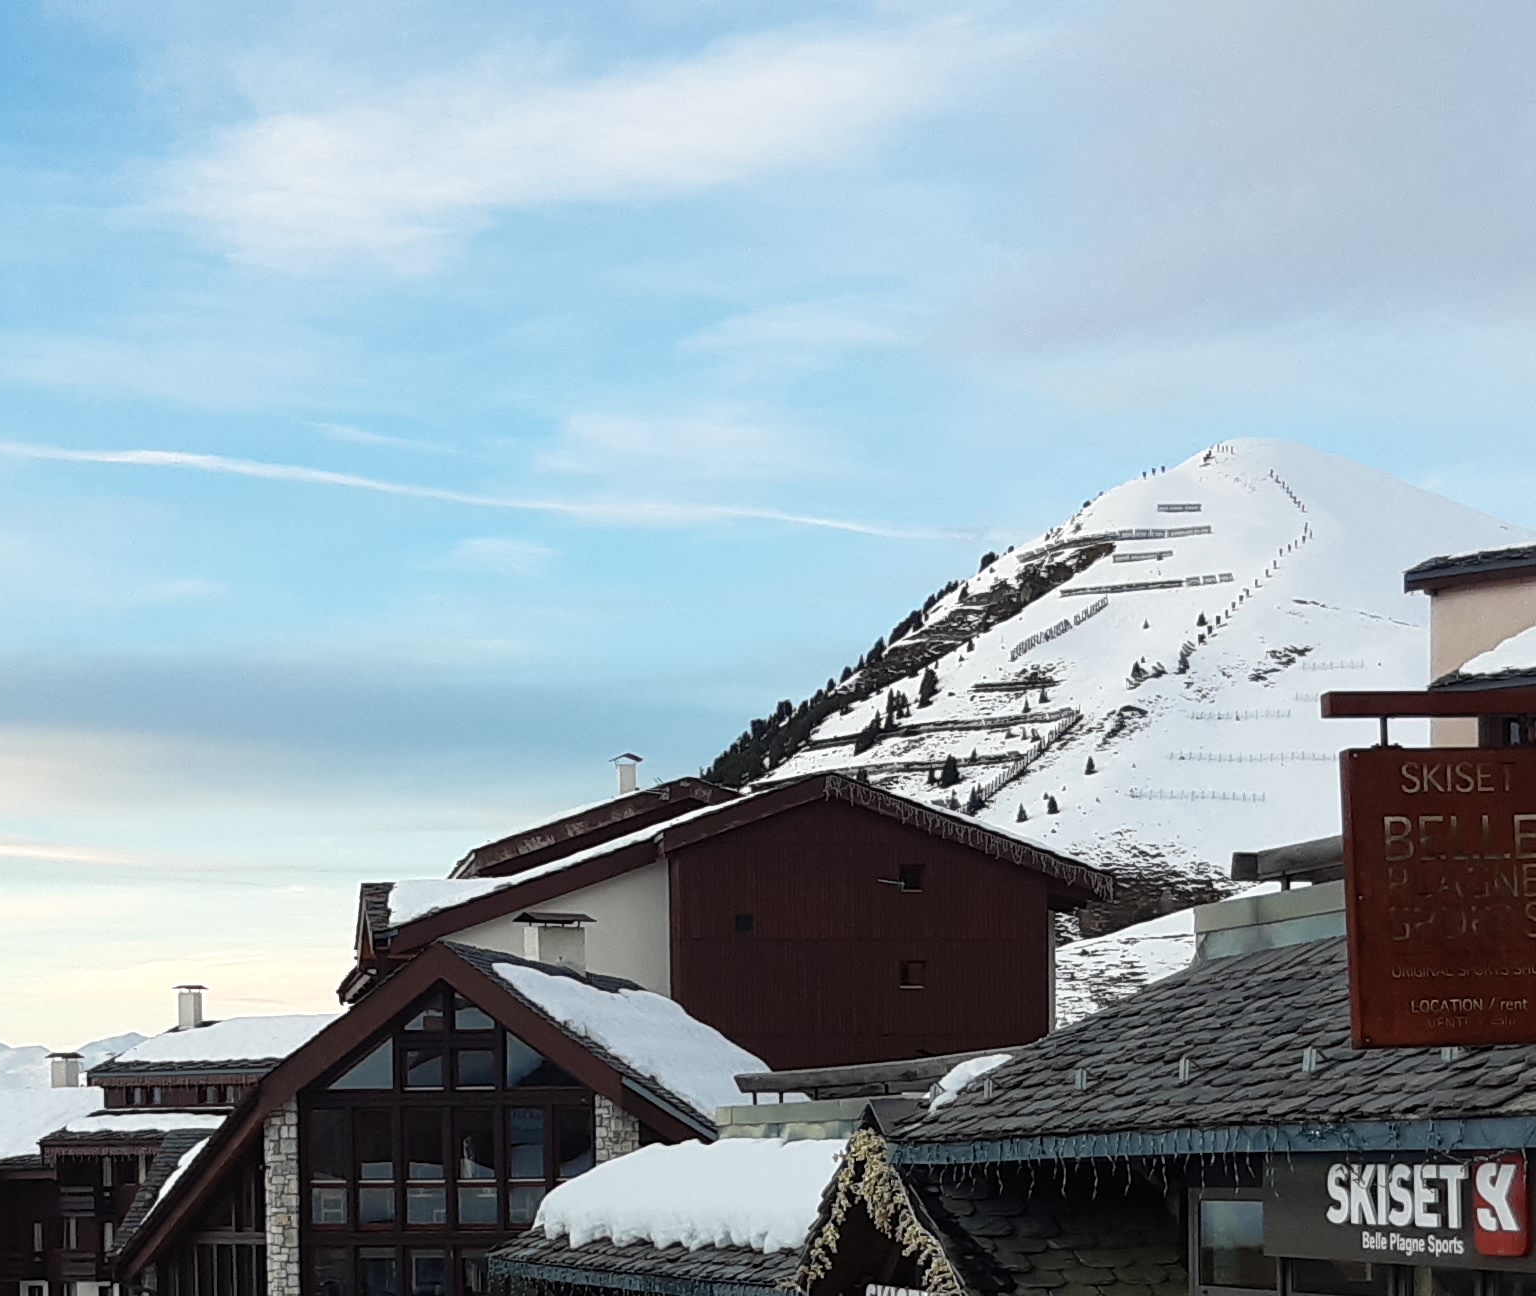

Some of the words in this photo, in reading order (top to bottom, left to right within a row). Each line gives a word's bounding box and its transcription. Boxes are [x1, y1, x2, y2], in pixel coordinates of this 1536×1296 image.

[1401, 762, 1515, 793] SKISET
[1410, 999, 1483, 1013] LOCATION
[1500, 999, 1529, 1011] rent
[1325, 1163, 1469, 1229] SKISET
[1362, 1231, 1387, 1251] Belle
[1389, 1232, 1425, 1256] Plagne
[1427, 1234, 1465, 1257] Sports
